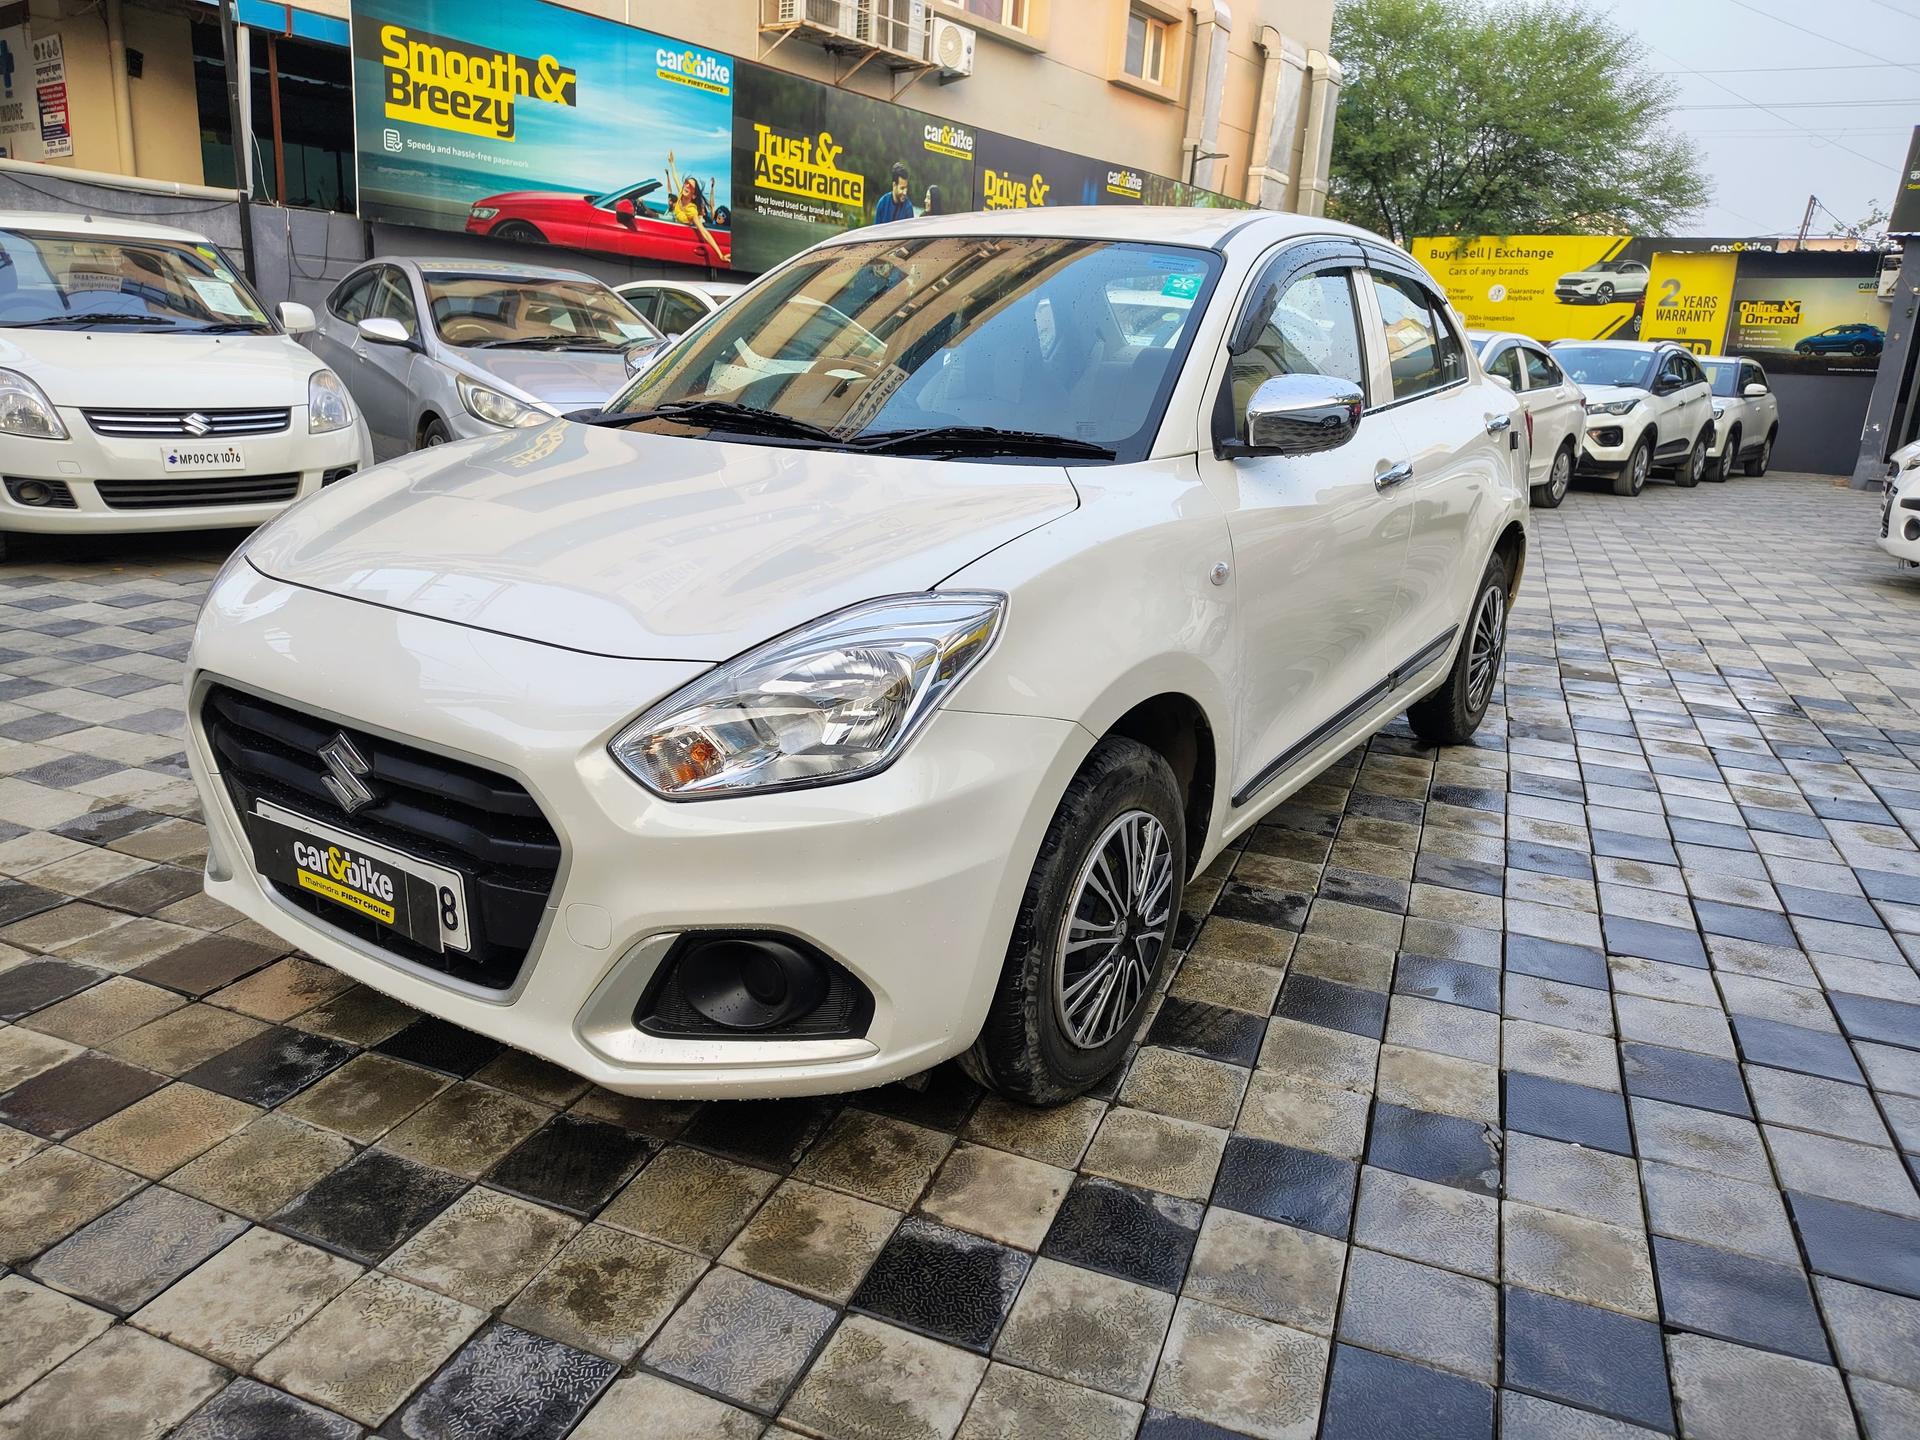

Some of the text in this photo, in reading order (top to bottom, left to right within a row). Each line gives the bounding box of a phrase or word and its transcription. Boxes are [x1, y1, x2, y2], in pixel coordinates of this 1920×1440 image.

[381, 25, 576, 105] Smooth &
[656, 49, 730, 84] car&bike
[687, 79, 703, 88] FIRST
[704, 83, 723, 93] CHOICE
[384, 68, 514, 138] Breezy
[754, 123, 843, 170] Trust &
[924, 125, 973, 150] car&bike
[407, 139, 529, 168] Speedy and hassle-free paperwork
[755, 154, 862, 201] Assurance
[984, 169, 1027, 201] Drive
[1030, 174, 1050, 206] &
[755, 195, 769, 204] Most
[770, 197, 785, 208] loved
[786, 201, 799, 210] Used
[800, 204, 808, 212] Car
[809, 205, 824, 215] brand
[831, 210, 844, 219] India
[758, 205, 766, 215] By
[767, 207, 793, 219] Franchise
[809, 215, 816, 223] ET
[1430, 249, 1452, 260] Buy
[1462, 248, 1484, 259] Sell
[1495, 248, 1554, 261] Exchange
[1449, 267, 1529, 277] Cars of any brands
[1658, 278, 1718, 309] 2 YEARS
[1739, 299, 1801, 314] Online &
[1483, 314, 1515, 323] inspection
[1656, 309, 1715, 322] WARRANTY
[1745, 313, 1800, 325] On-road
[1676, 327, 1687, 336] ON
[293, 841, 394, 902] car&bike
[304, 876, 391, 919] mahindra FIRST CHOICE
[440, 885, 459, 932] 8
